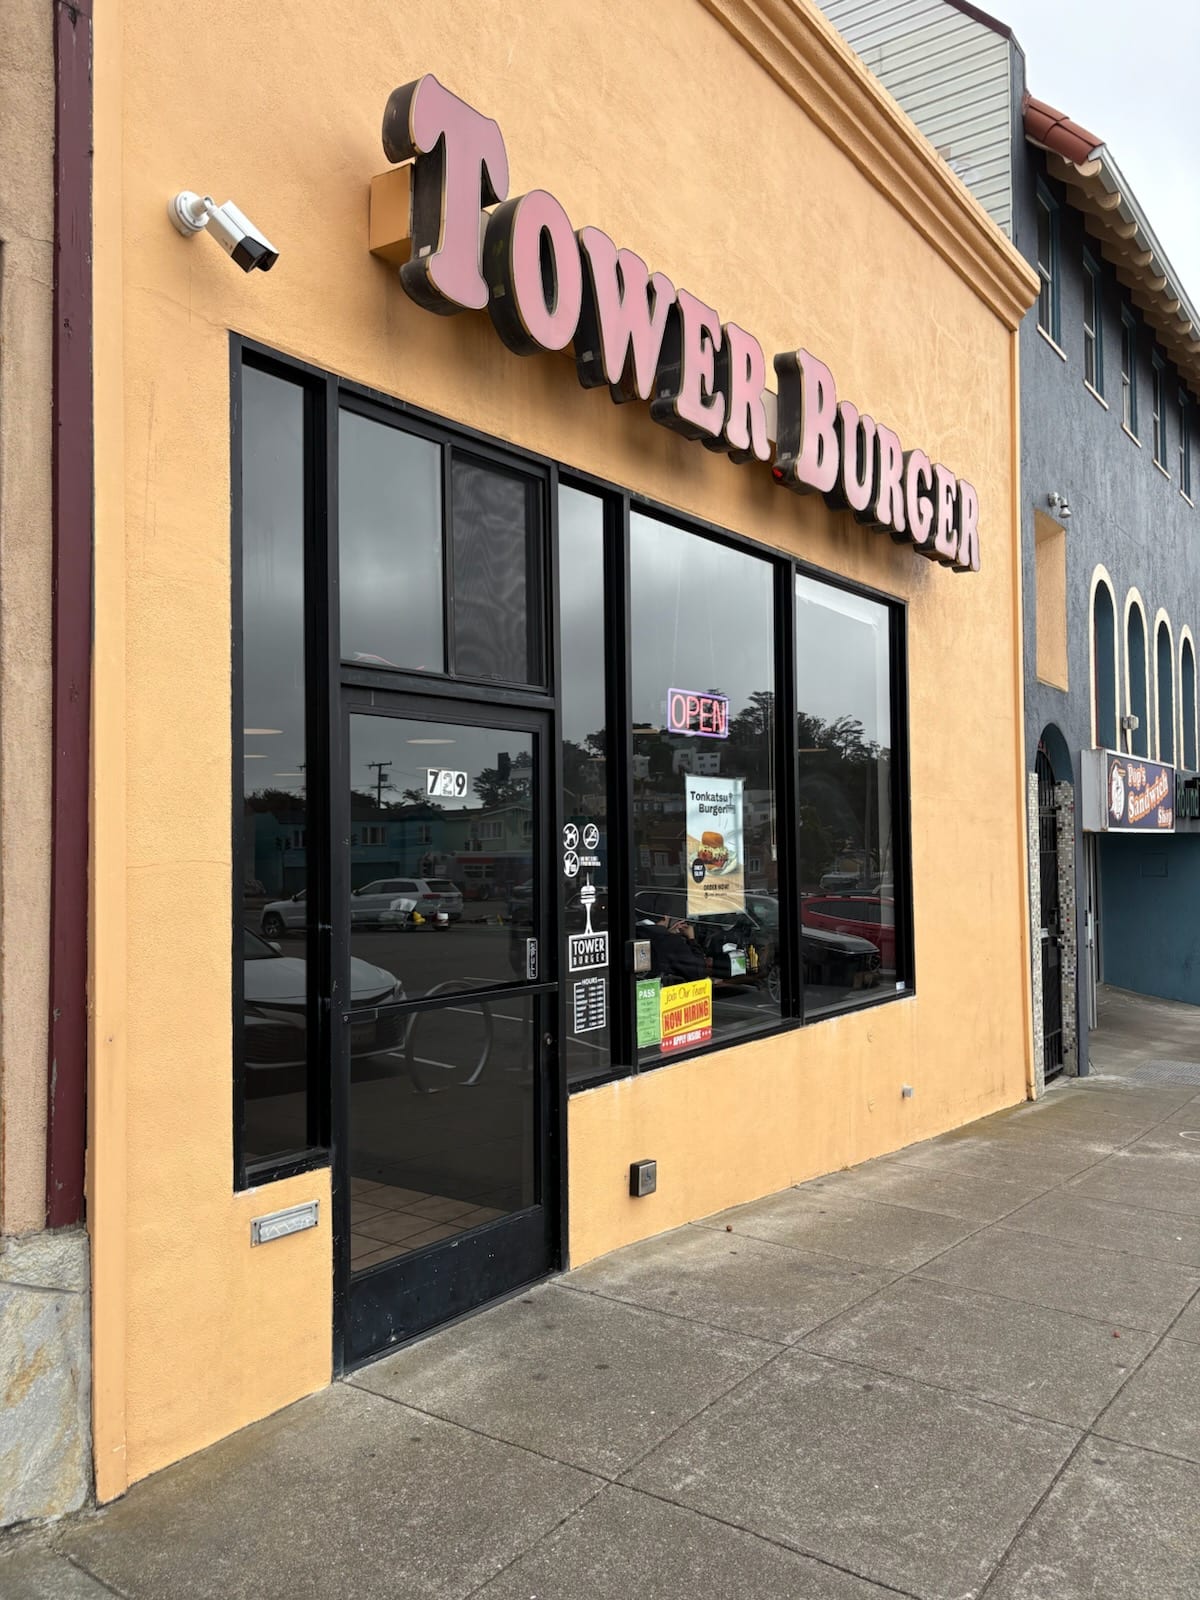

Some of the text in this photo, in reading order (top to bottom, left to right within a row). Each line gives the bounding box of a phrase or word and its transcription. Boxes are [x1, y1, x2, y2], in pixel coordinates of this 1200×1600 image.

[403, 74, 981, 572] TOWER BURGER
[671, 694, 726, 733] OPEN
[429, 770, 466, 796] 729
[690, 790, 729, 803] Tonkatsu
[1127, 768, 1169, 824] Sandwich
[698, 803, 727, 816] Burger
[1158, 806, 1173, 829] Shop
[573, 938, 604, 955] TOWER
[573, 953, 605, 966] BURGER
[581, 977, 598, 985] HOURS
[638, 988, 655, 998] PASS
[680, 987, 690, 1000] Our
[664, 1009, 682, 1032] NOW
[684, 1000, 709, 1024] HIRING
